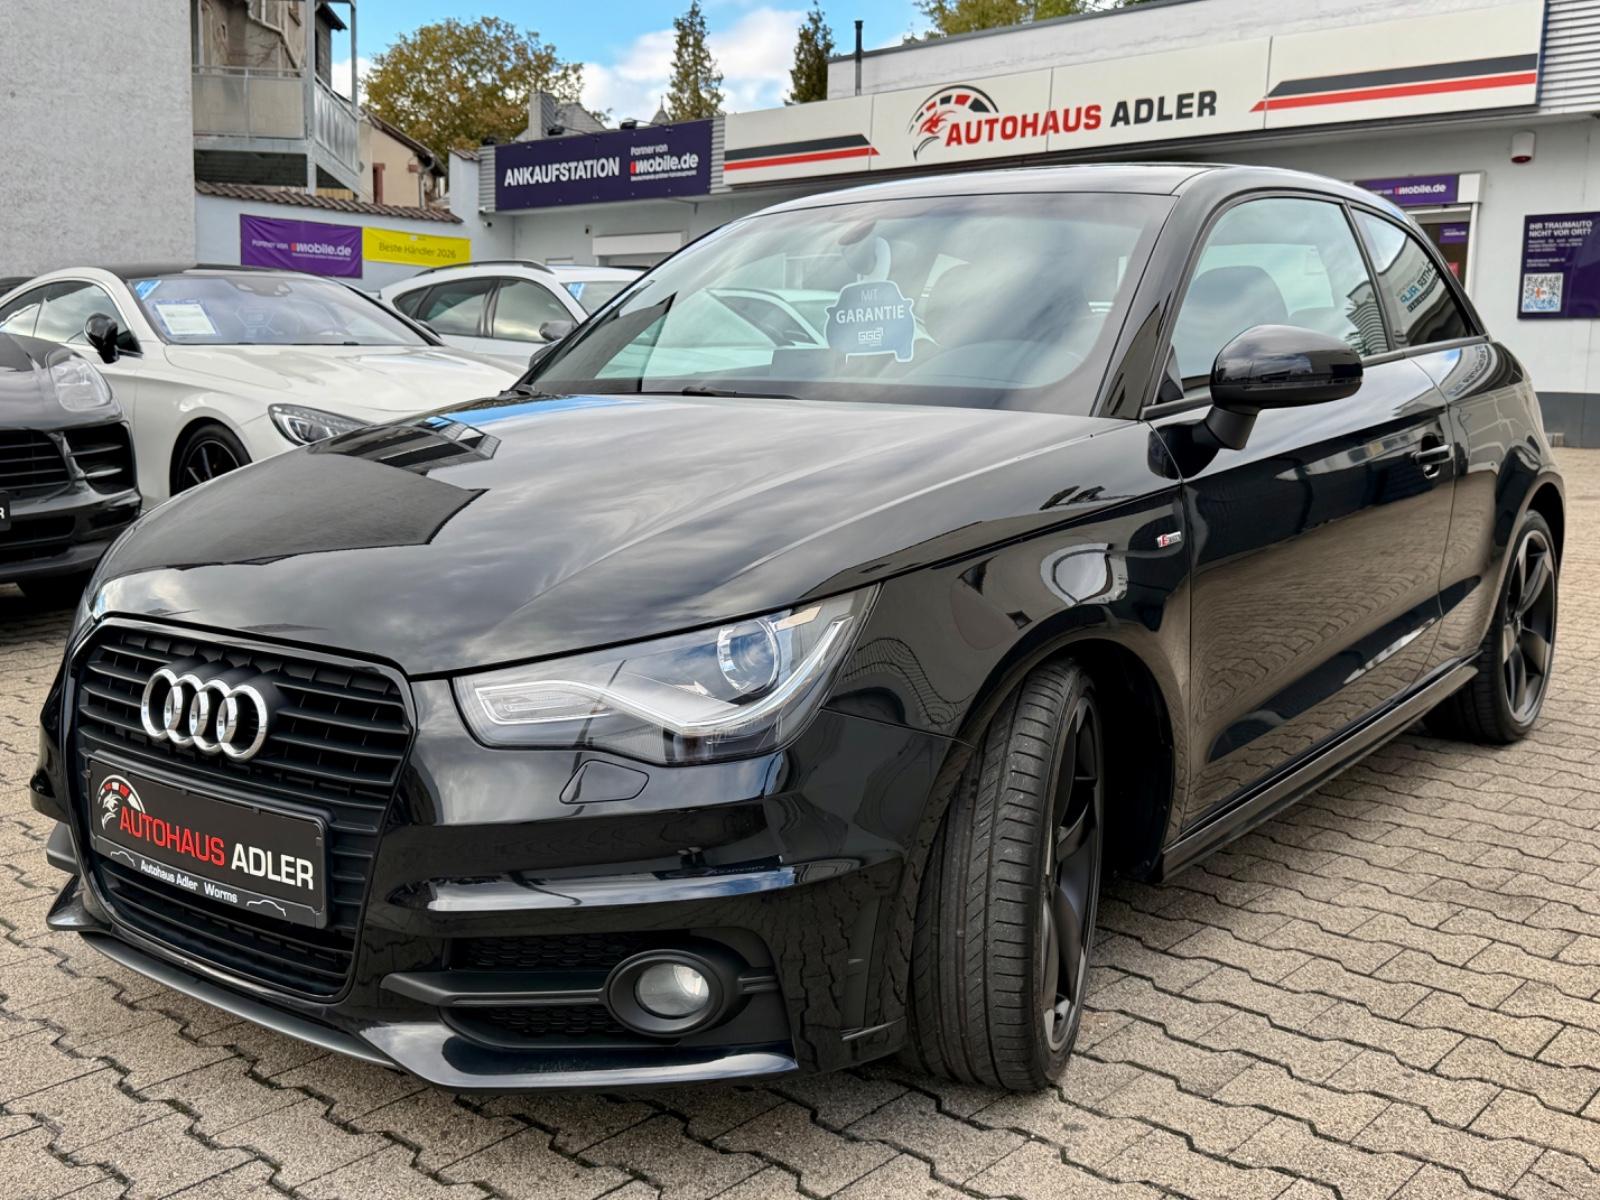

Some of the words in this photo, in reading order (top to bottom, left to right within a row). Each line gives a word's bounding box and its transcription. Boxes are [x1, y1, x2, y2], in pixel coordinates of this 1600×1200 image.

[945, 104, 1102, 147] AUTOHAUS
[1110, 90, 1218, 128] ADLER
[504, 156, 620, 187] ANKAUFSTATION
[635, 152, 699, 173] mobile.de
[1399, 184, 1447, 195] mobile.de
[1544, 220, 1593, 229] TRAUMAUTO
[296, 242, 352, 256] mobile.de
[378, 241, 403, 253] Beste
[836, 304, 905, 324] GARANTIE
[119, 805, 225, 867] AUTOHAUS
[231, 842, 314, 891] ADLER
[140, 859, 176, 883] Autohaus
[176, 873, 199, 891] Adler
[203, 882, 239, 904] Worms
